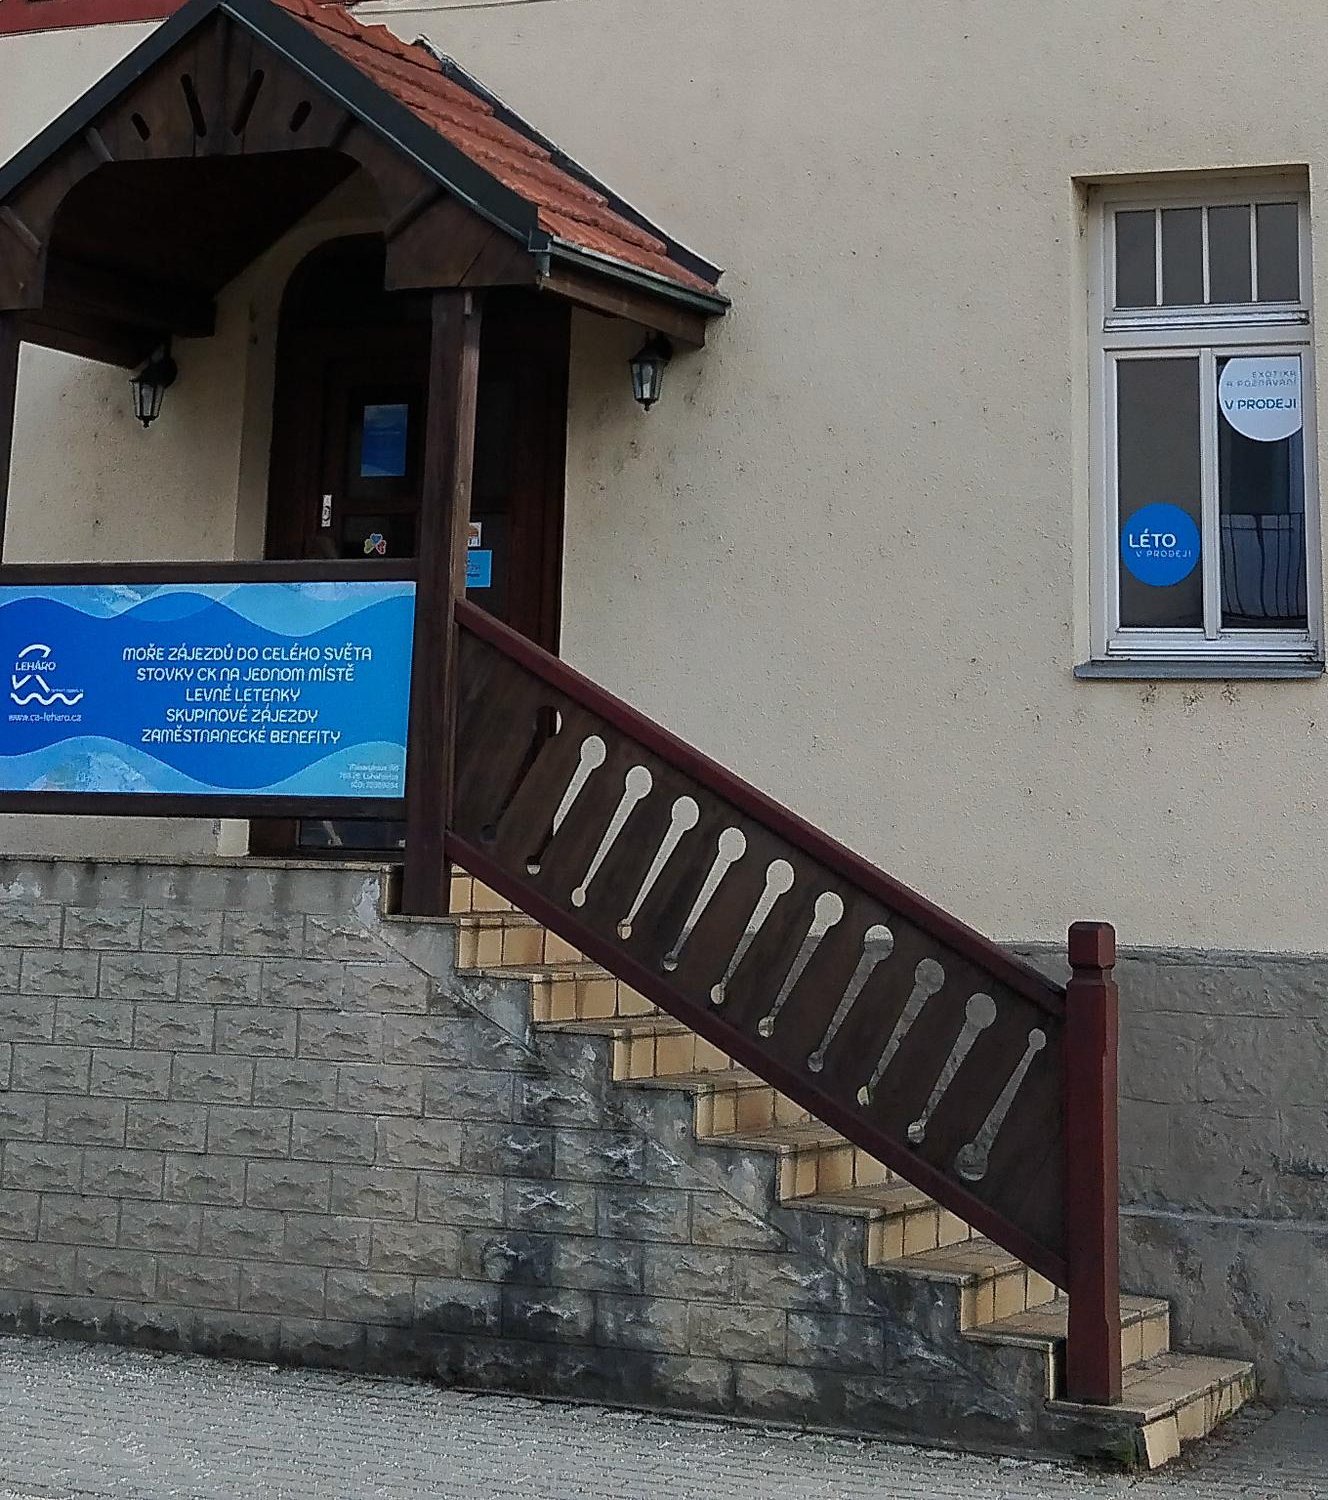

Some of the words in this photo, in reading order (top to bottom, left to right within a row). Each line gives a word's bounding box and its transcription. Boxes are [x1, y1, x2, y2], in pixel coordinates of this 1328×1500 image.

[1251, 370, 1297, 379] EXOTIKA
[1224, 399, 1234, 410] V
[1237, 398, 1297, 410] PRODEJI
[1128, 528, 1177, 549] LÉTO
[1135, 550, 1143, 558] V
[1146, 549, 1192, 558] PRODEJI
[122, 643, 165, 661] MOŘE
[167, 643, 235, 661] ZÁJEZDŮ
[237, 647, 260, 661] DO
[262, 643, 321, 661] CELÉHO
[323, 643, 373, 661] SVĚTA
[136, 667, 194, 682] STOVKY
[196, 667, 217, 682] CK
[220, 667, 240, 682] NA
[242, 667, 306, 682] JEDNOM
[308, 663, 355, 682] MÍSTĚ
[185, 684, 232, 702] LEVNÉ
[235, 687, 302, 703] LETENKY
[166, 704, 248, 723] SKUPINOVÉ
[250, 703, 319, 723] ZÁJEZDY
[141, 725, 267, 744] ZAMĚSTNANECKÉ
[270, 729, 342, 744] BENEFITY
